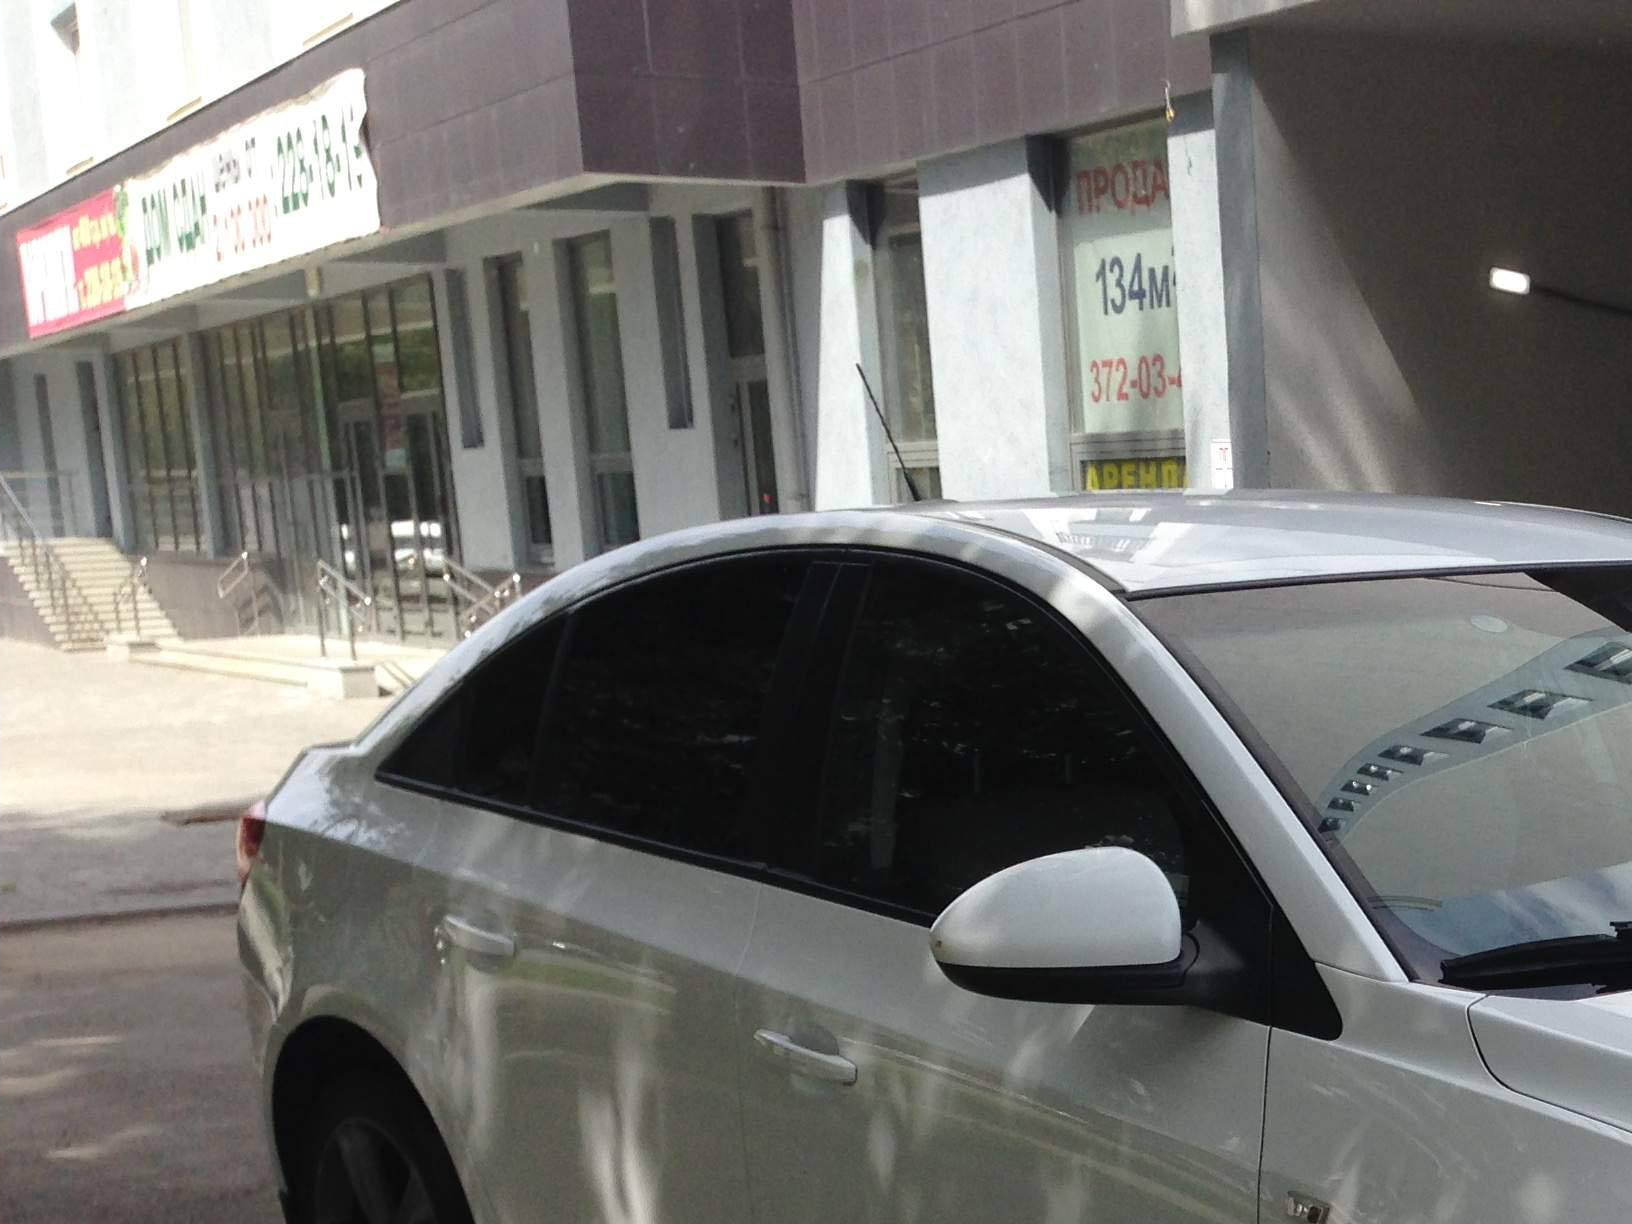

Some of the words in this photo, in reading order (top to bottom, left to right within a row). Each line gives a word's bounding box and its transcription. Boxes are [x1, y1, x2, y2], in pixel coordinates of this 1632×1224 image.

[1095, 246, 1177, 317] 134м
[1089, 353, 1182, 404] 372-03-
[1086, 456, 1188, 492] АРЕНД
